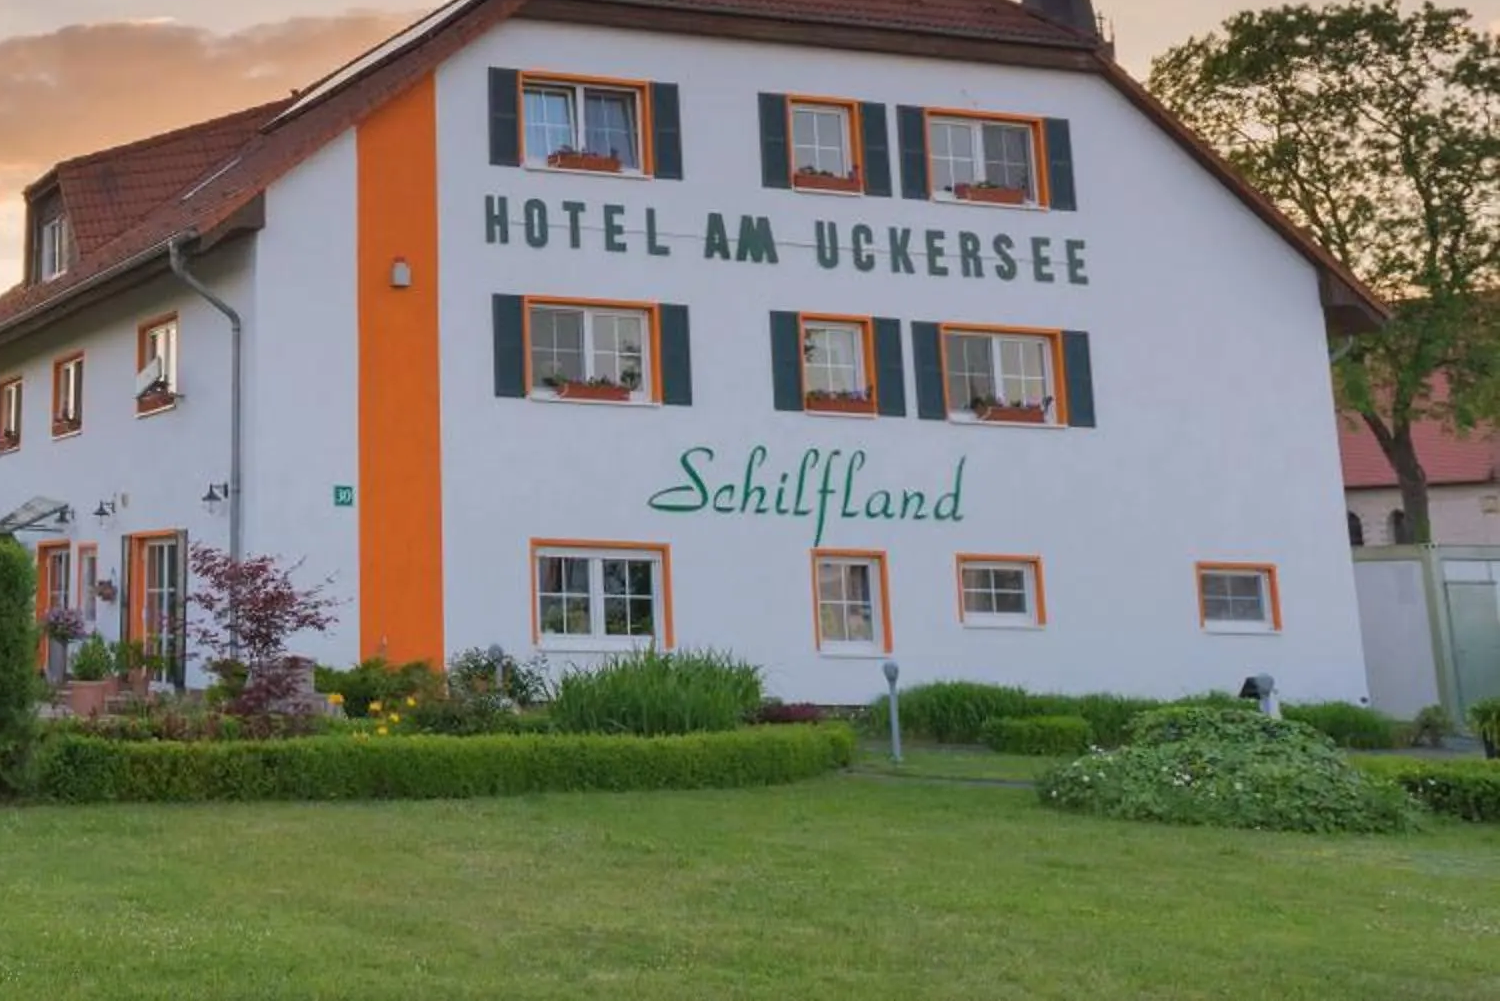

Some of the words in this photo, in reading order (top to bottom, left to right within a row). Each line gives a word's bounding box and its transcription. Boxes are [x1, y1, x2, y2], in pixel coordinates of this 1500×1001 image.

[484, 195, 671, 257] HOTEL
[703, 212, 779, 265] AM
[814, 220, 1090, 286] UCKERSEE
[647, 445, 967, 548] Schilfland
